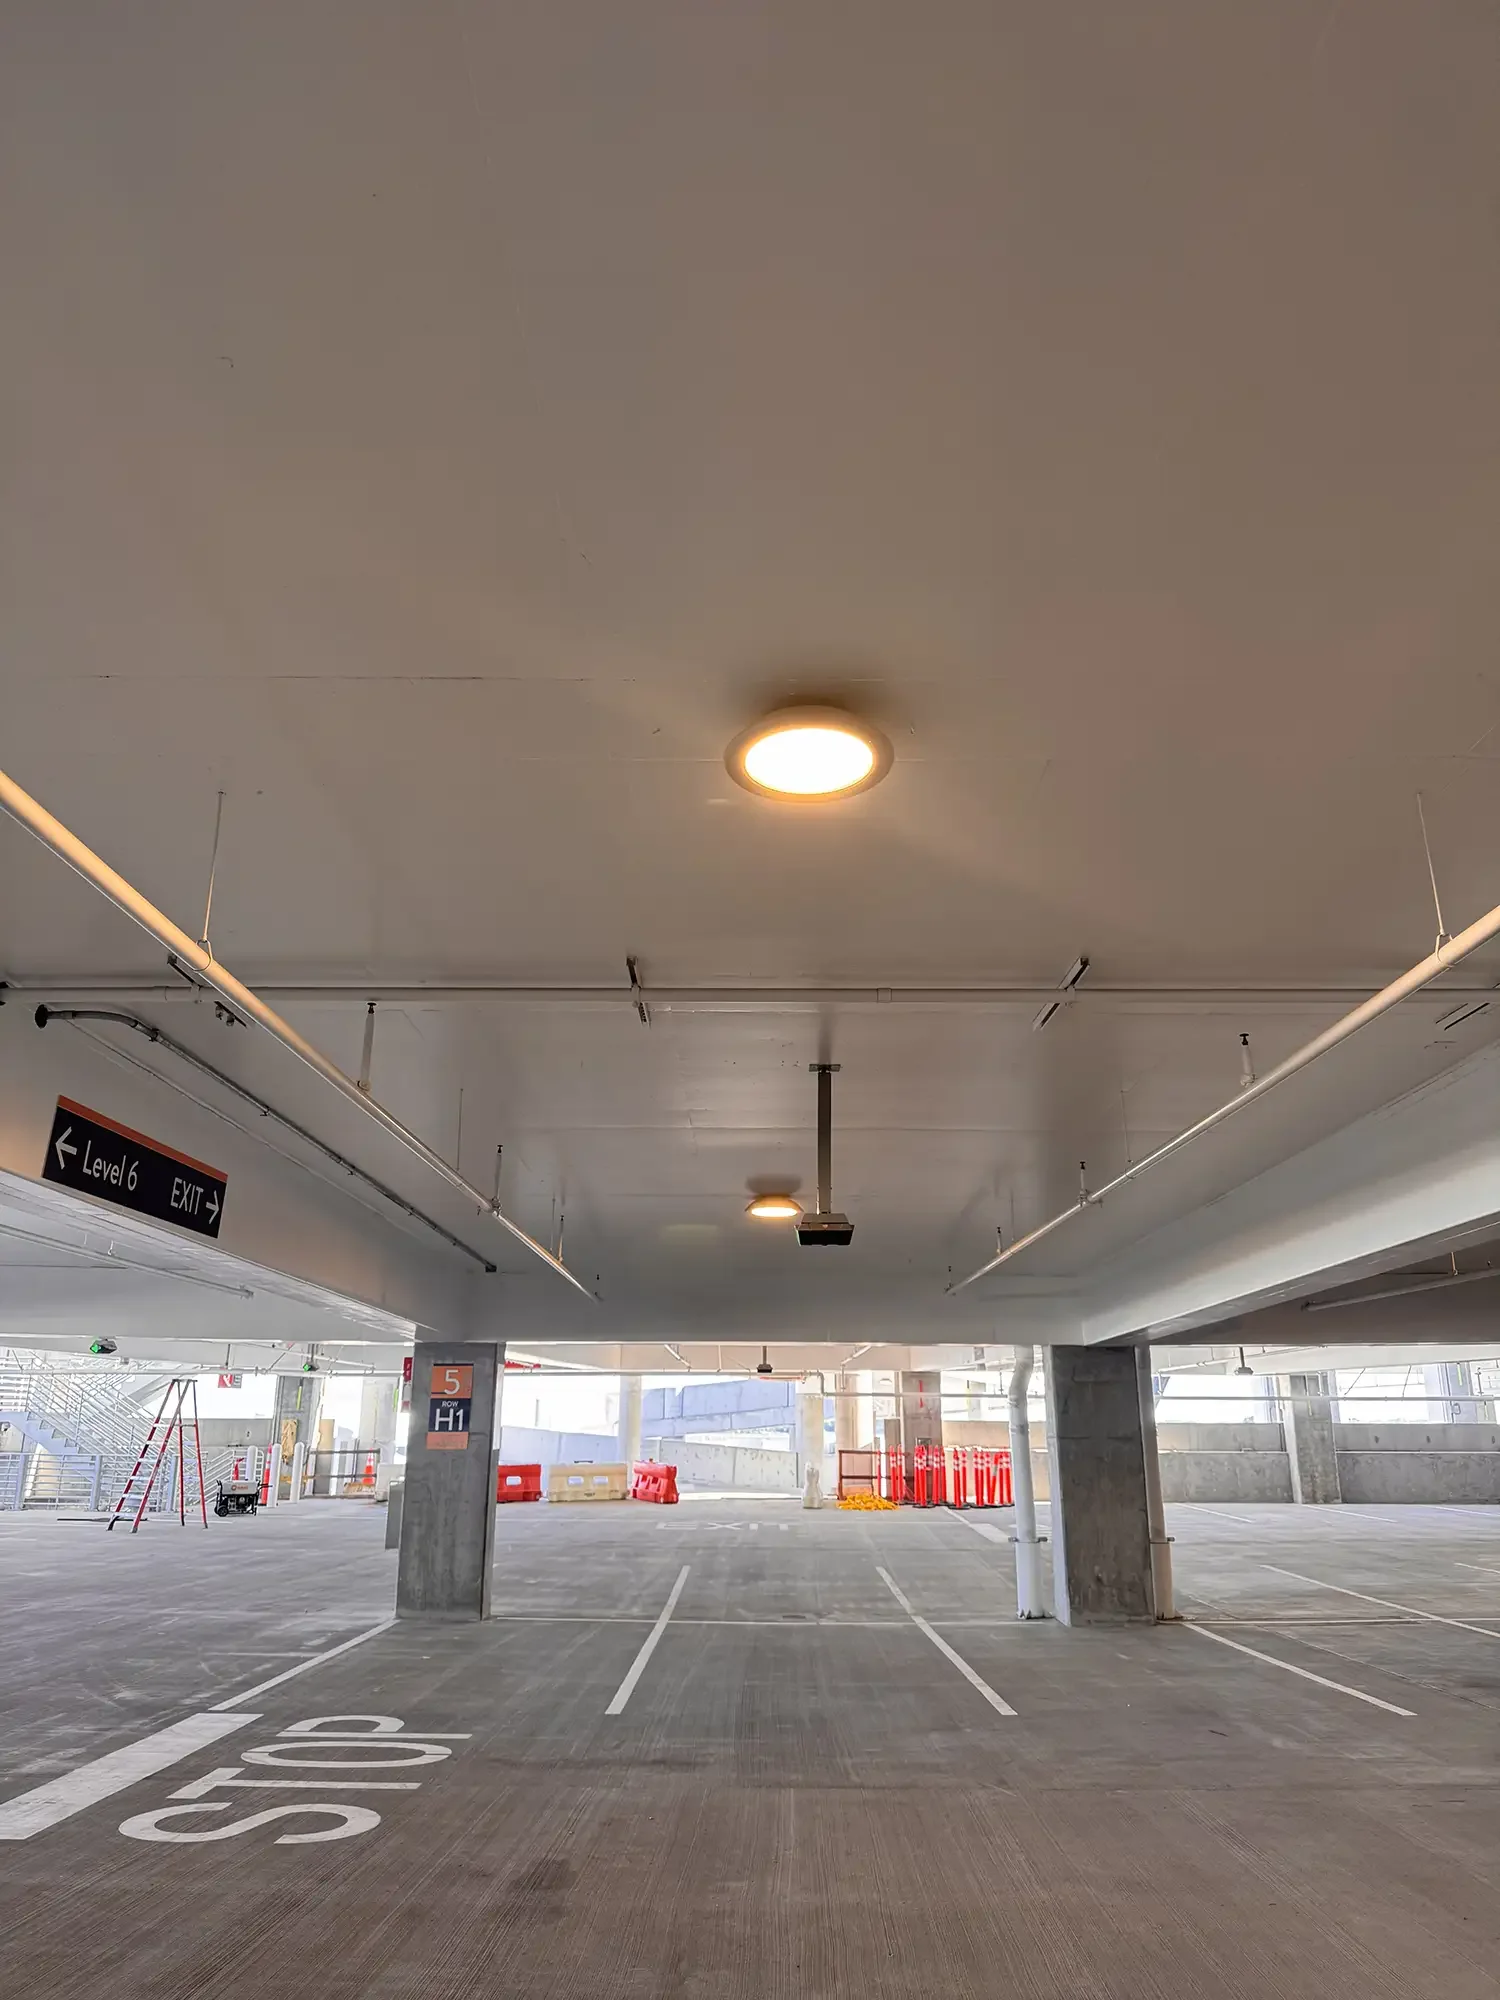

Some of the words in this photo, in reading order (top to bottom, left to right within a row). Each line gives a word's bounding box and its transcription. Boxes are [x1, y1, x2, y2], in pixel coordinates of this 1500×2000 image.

[82, 1140, 126, 1186] Level
[127, 1160, 139, 1191] 6
[170, 1177, 204, 1215] EXIT
[444, 1369, 460, 1395] 5
[441, 1400, 459, 1408] ROW
[434, 1408, 464, 1431] H1
[655, 1521, 803, 1531] EXIT
[118, 1714, 473, 1845] STOP
